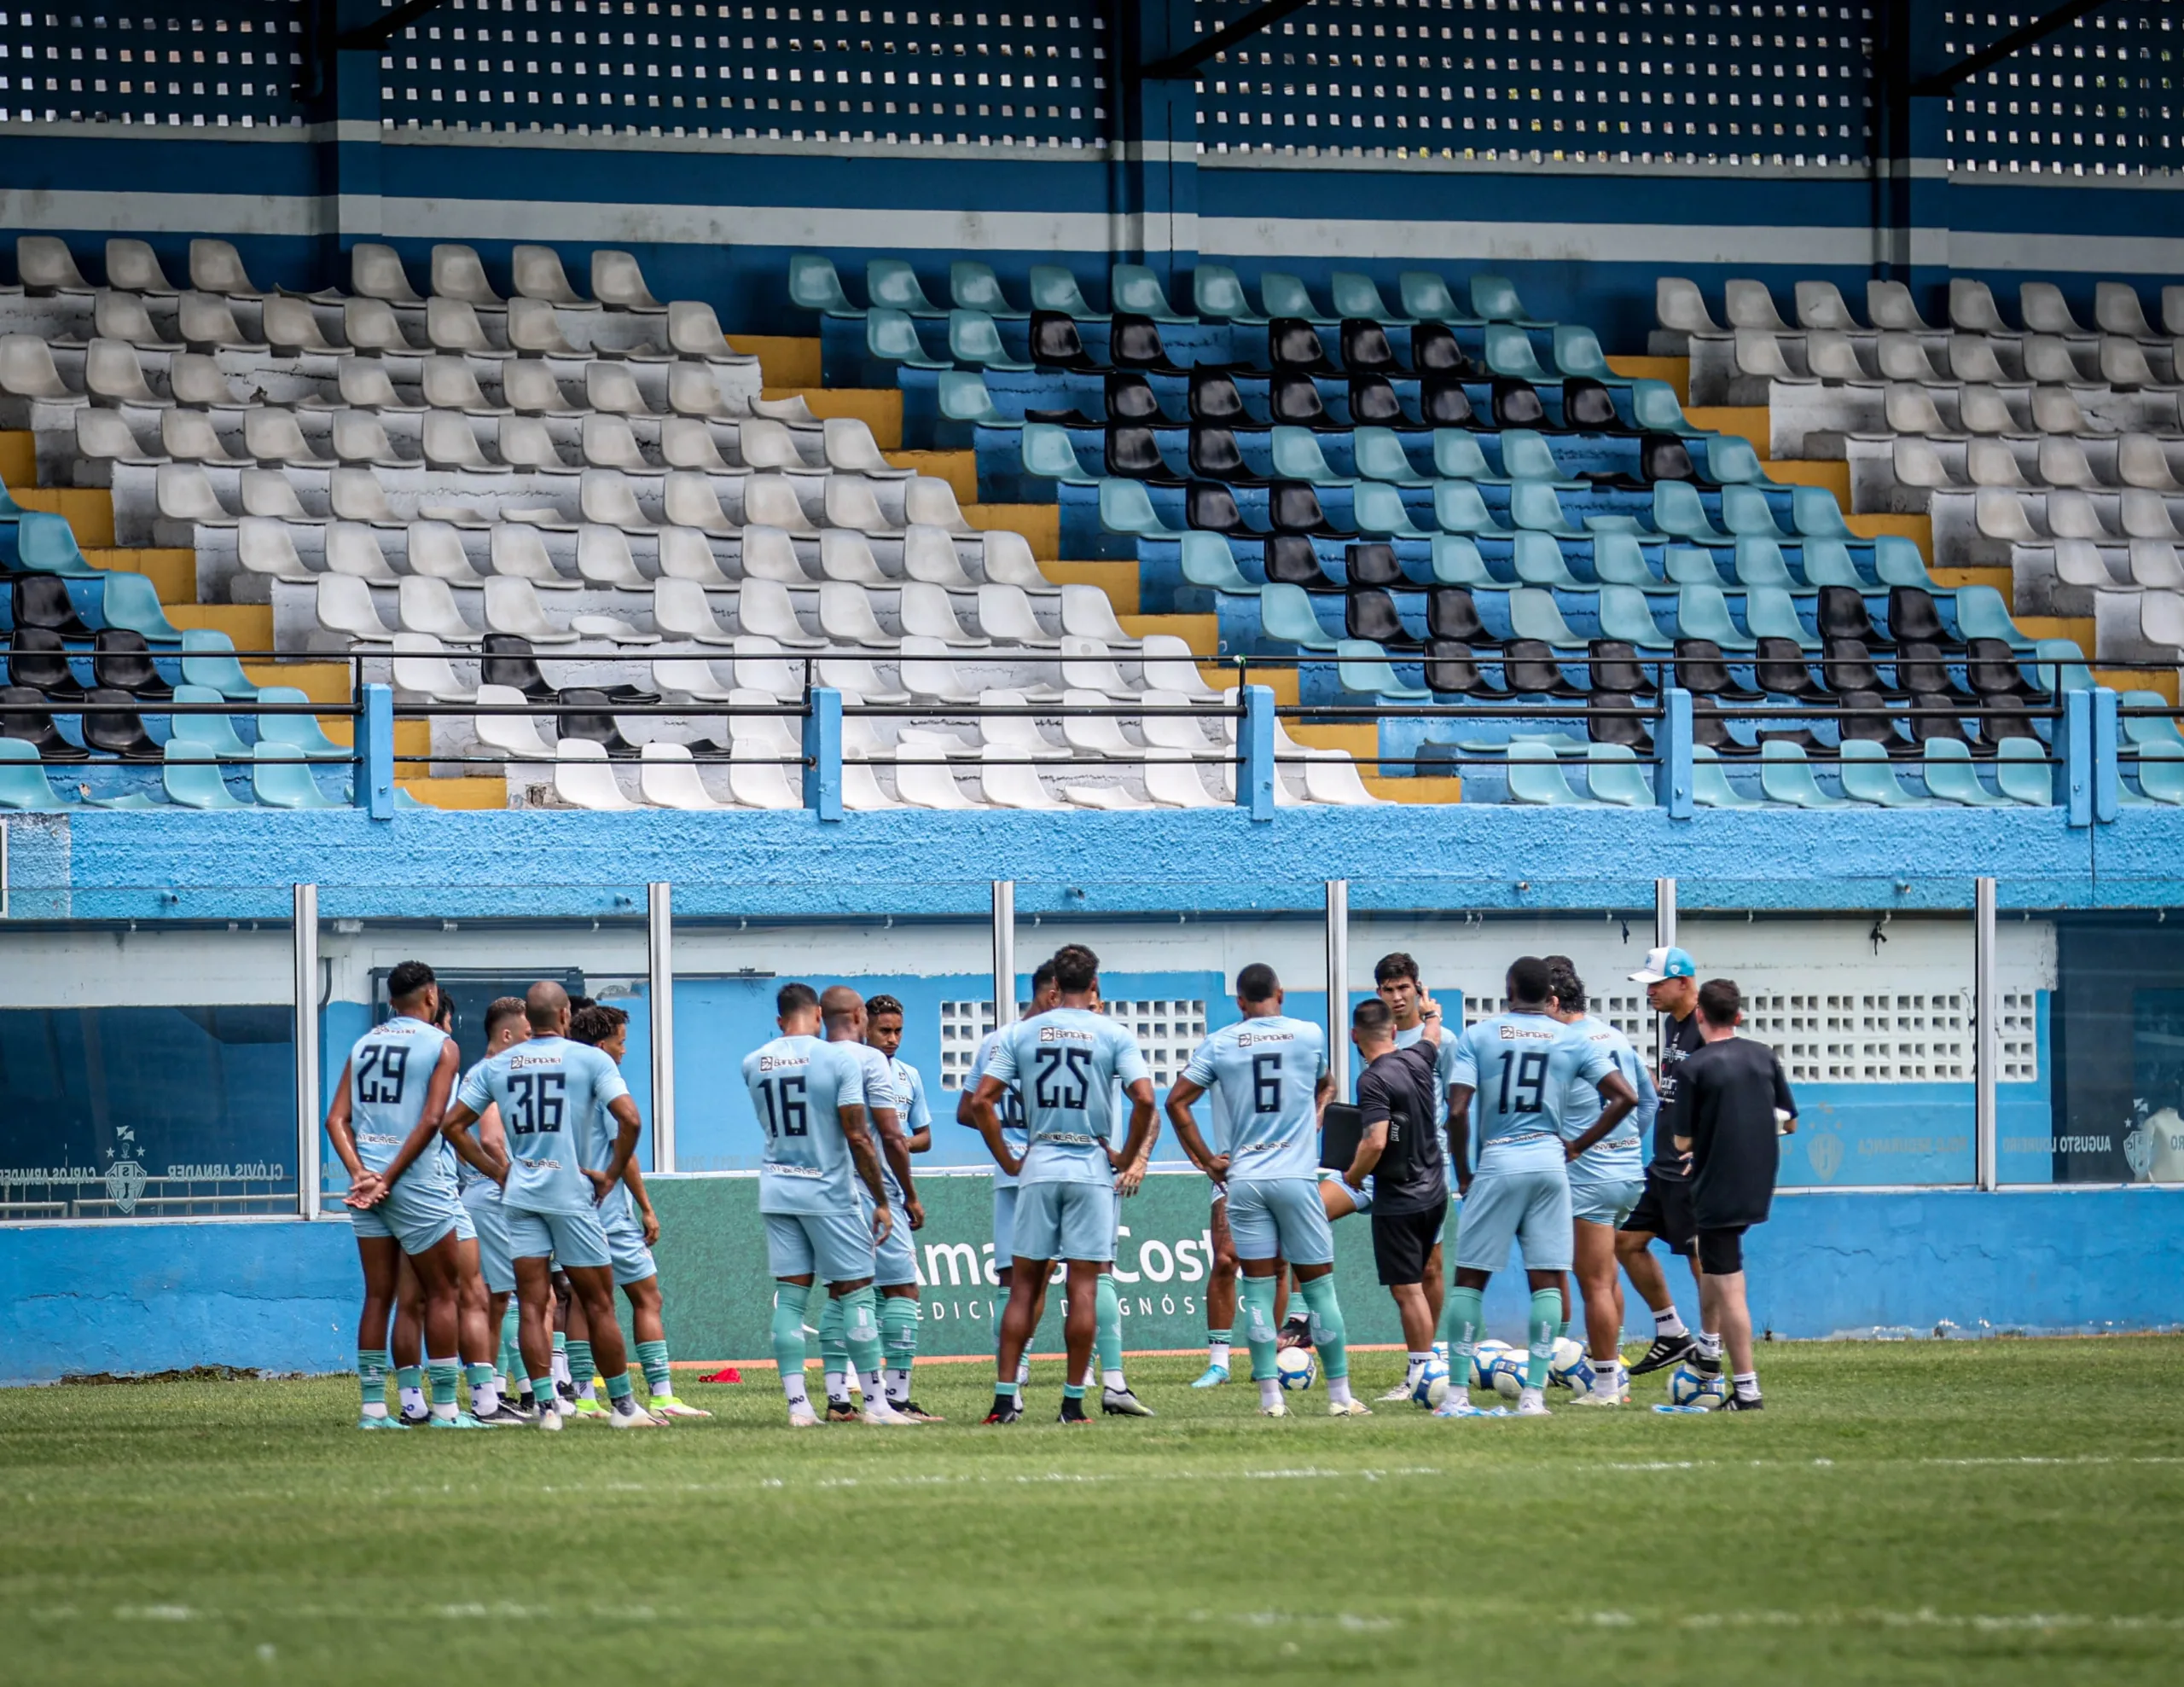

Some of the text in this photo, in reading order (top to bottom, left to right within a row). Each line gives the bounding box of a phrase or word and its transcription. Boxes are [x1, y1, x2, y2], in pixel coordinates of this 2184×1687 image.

[357, 1045, 410, 1104] 29
[507, 1072, 566, 1134] 36
[1035, 1047, 1093, 1110] 25
[1252, 1052, 1281, 1113] 6
[1498, 1050, 1549, 1114] 19
[757, 1075, 808, 1138] 16
[1111, 1226, 1243, 1283] Cost
